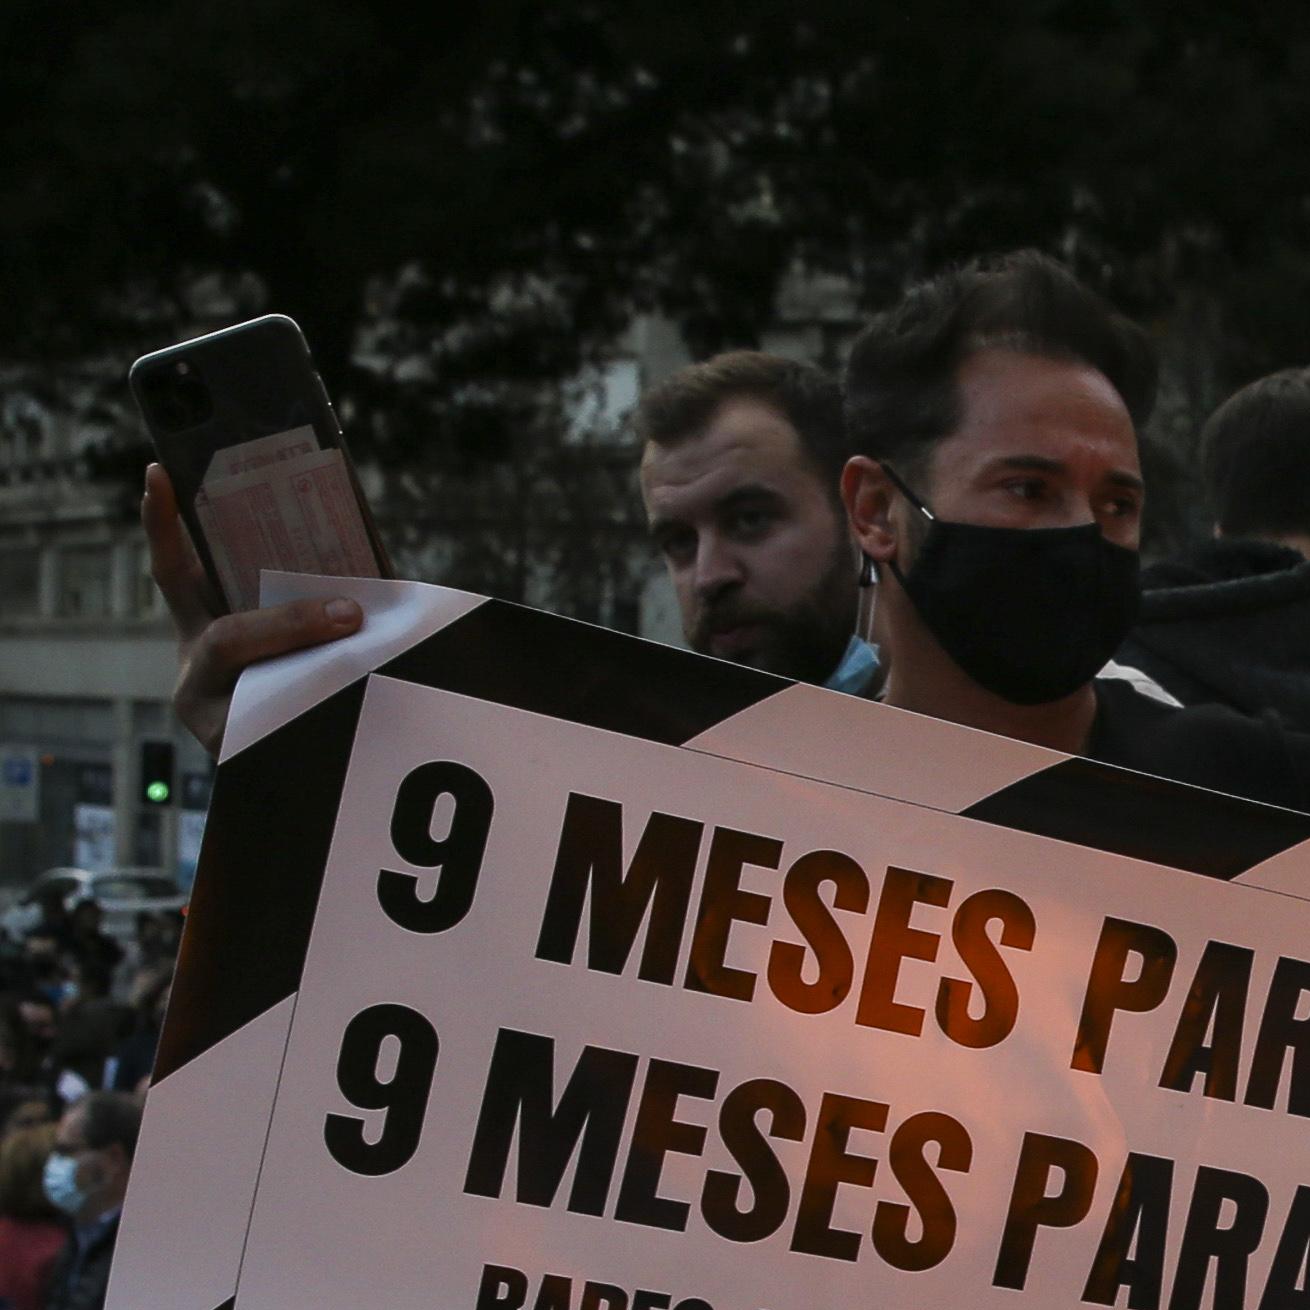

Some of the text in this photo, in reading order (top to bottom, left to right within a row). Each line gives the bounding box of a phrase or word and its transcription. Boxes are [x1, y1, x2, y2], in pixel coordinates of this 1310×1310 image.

[376, 760, 495, 934] 9
[535, 791, 1037, 1050] MESES
[324, 1003, 440, 1177] 9
[463, 1027, 973, 1273] MESES
